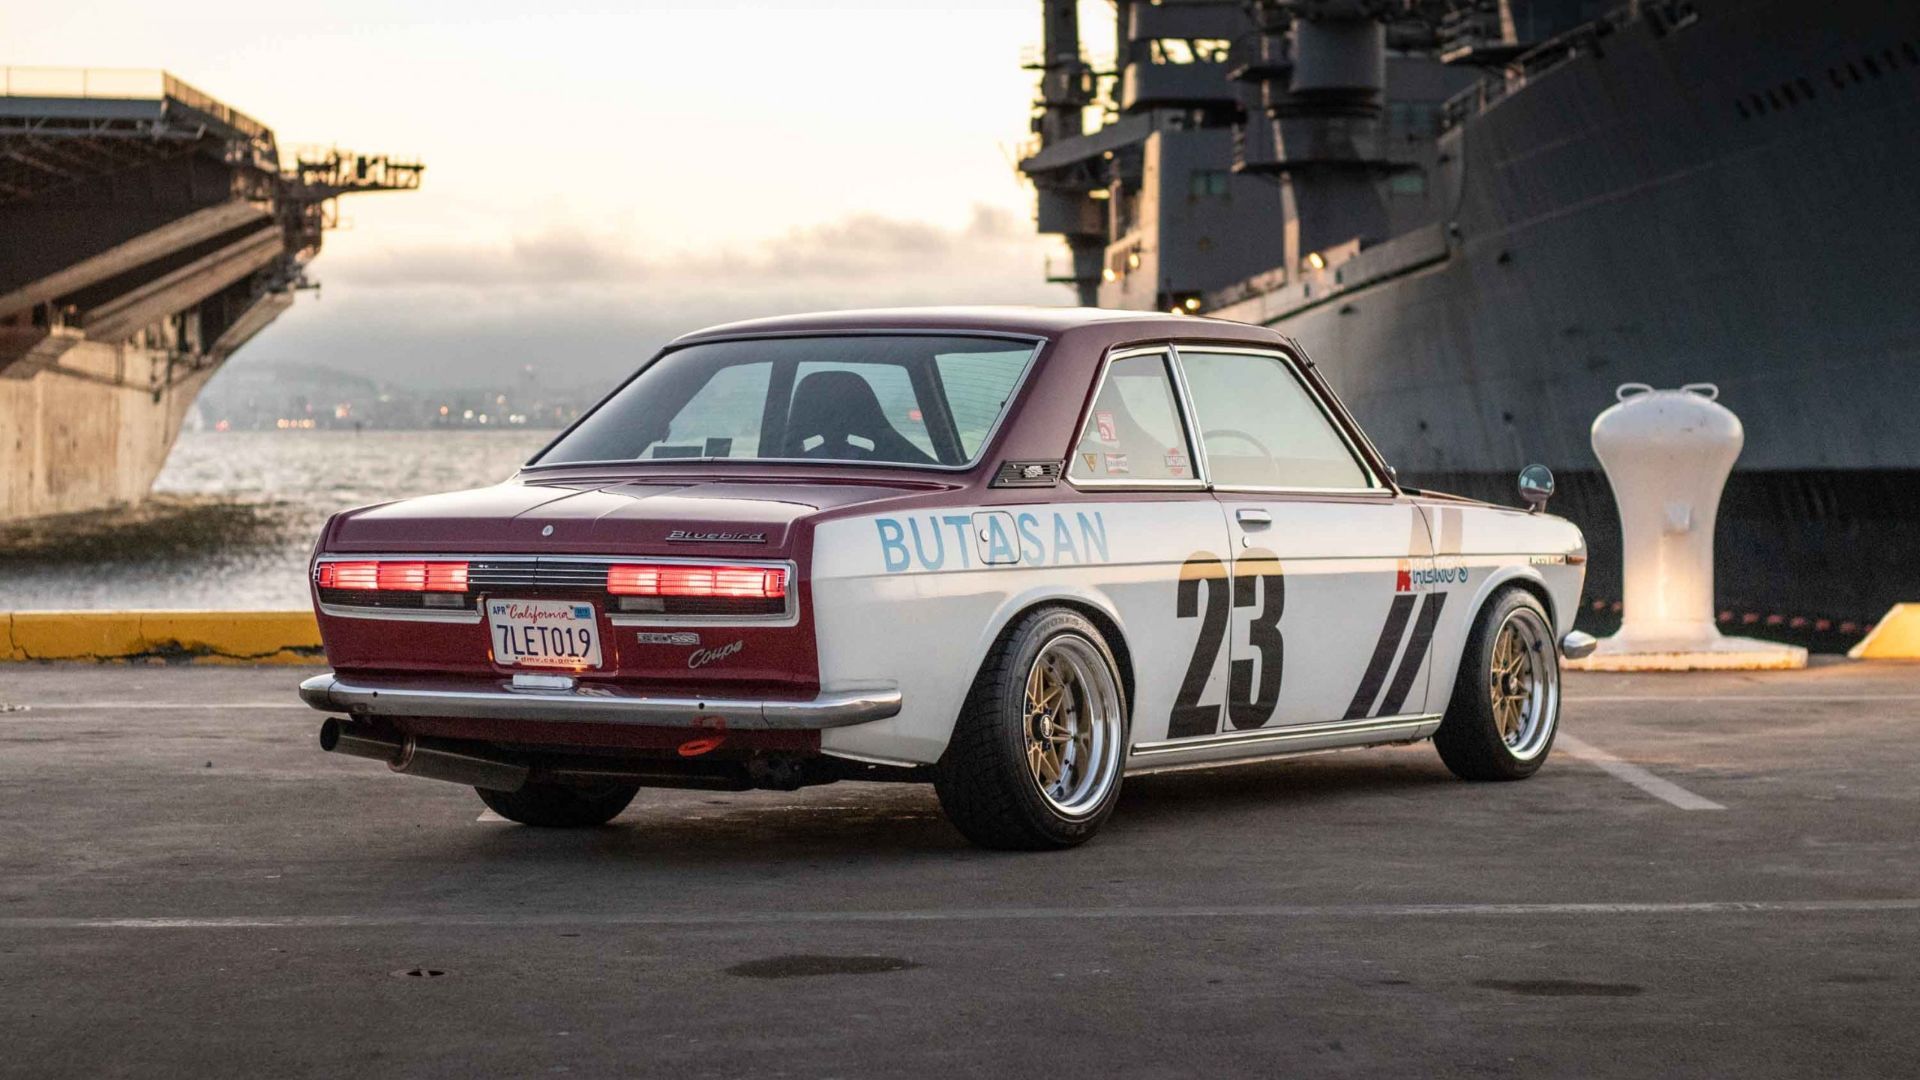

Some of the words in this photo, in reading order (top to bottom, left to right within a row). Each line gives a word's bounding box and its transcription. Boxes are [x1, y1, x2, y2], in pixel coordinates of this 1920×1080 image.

[669, 530, 763, 540] Bluebird
[875, 511, 1110, 572] BUTASAN
[492, 606, 506, 615] APR
[509, 603, 575, 624] California
[497, 624, 591, 658] 7LET019
[688, 640, 743, 669] Coupe
[1167, 547, 1285, 739] 23
